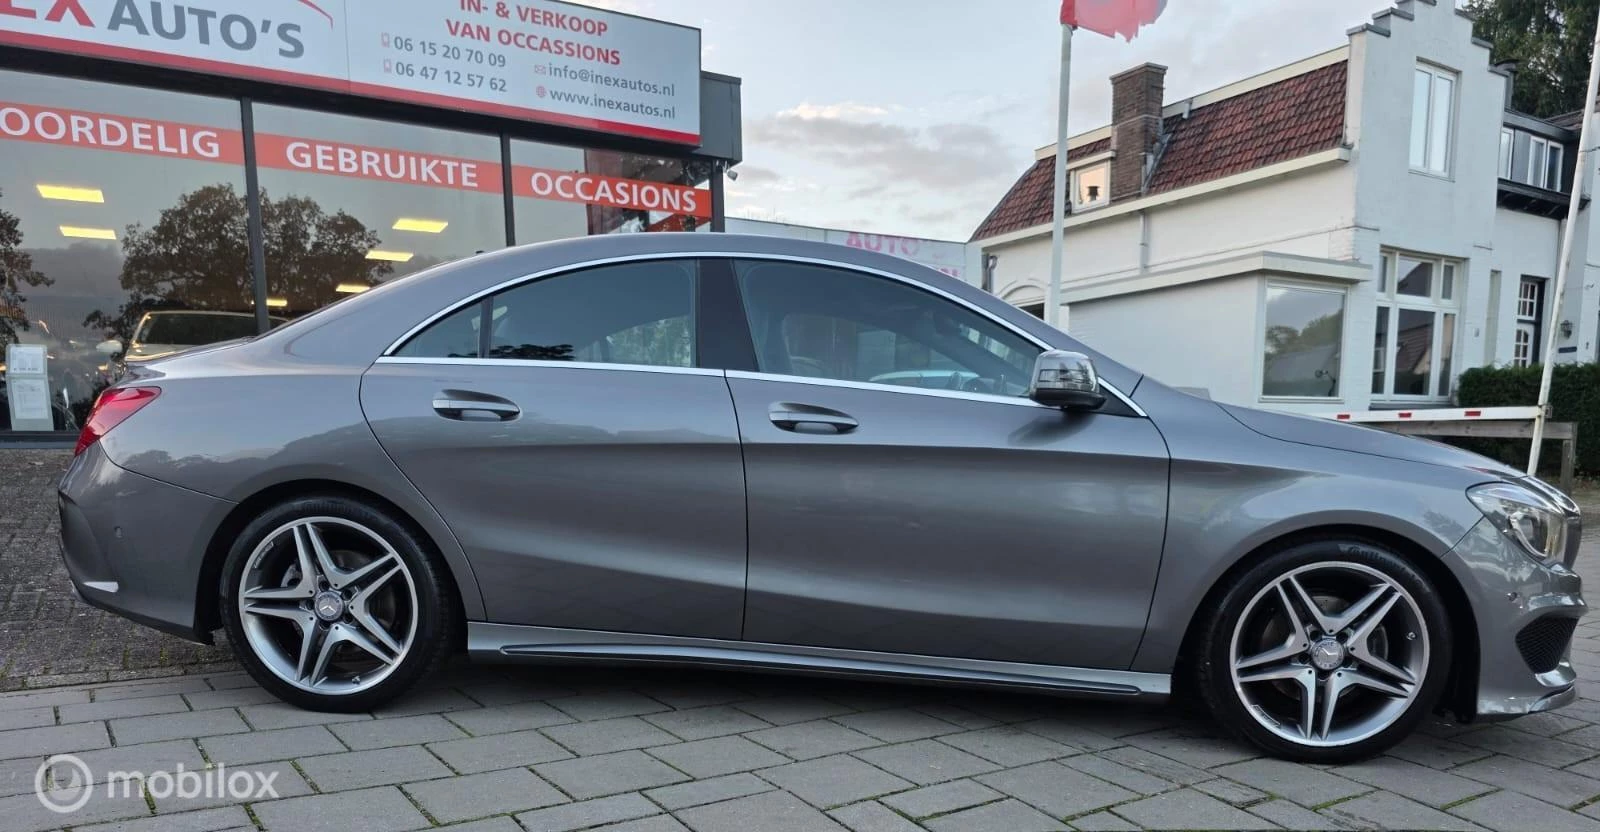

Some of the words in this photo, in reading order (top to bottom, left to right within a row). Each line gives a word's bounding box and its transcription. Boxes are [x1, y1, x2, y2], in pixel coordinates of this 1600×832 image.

[107, 0, 305, 59] AUTO'S
[495, 1, 510, 19] &
[516, 5, 609, 37] VERKOOP
[394, 35, 414, 52] 06
[420, 41, 437, 56] 15
[442, 44, 461, 61] 20
[466, 48, 484, 64] 70
[488, 52, 506, 68] 09
[445, 18, 491, 42] VAN
[497, 29, 621, 66] OCCASSIONS
[395, 61, 415, 78] 06
[420, 66, 438, 81] 47
[444, 70, 462, 86] 12
[467, 73, 484, 88] 57
[489, 77, 507, 92] 62
[549, 63, 676, 96] info@inexautos.nl
[550, 89, 676, 119] www.inexautos.nl
[0, 107, 220, 158] OORDELIG
[286, 142, 479, 188] GEBRUIKTE
[531, 172, 697, 212] OCCASIONS
